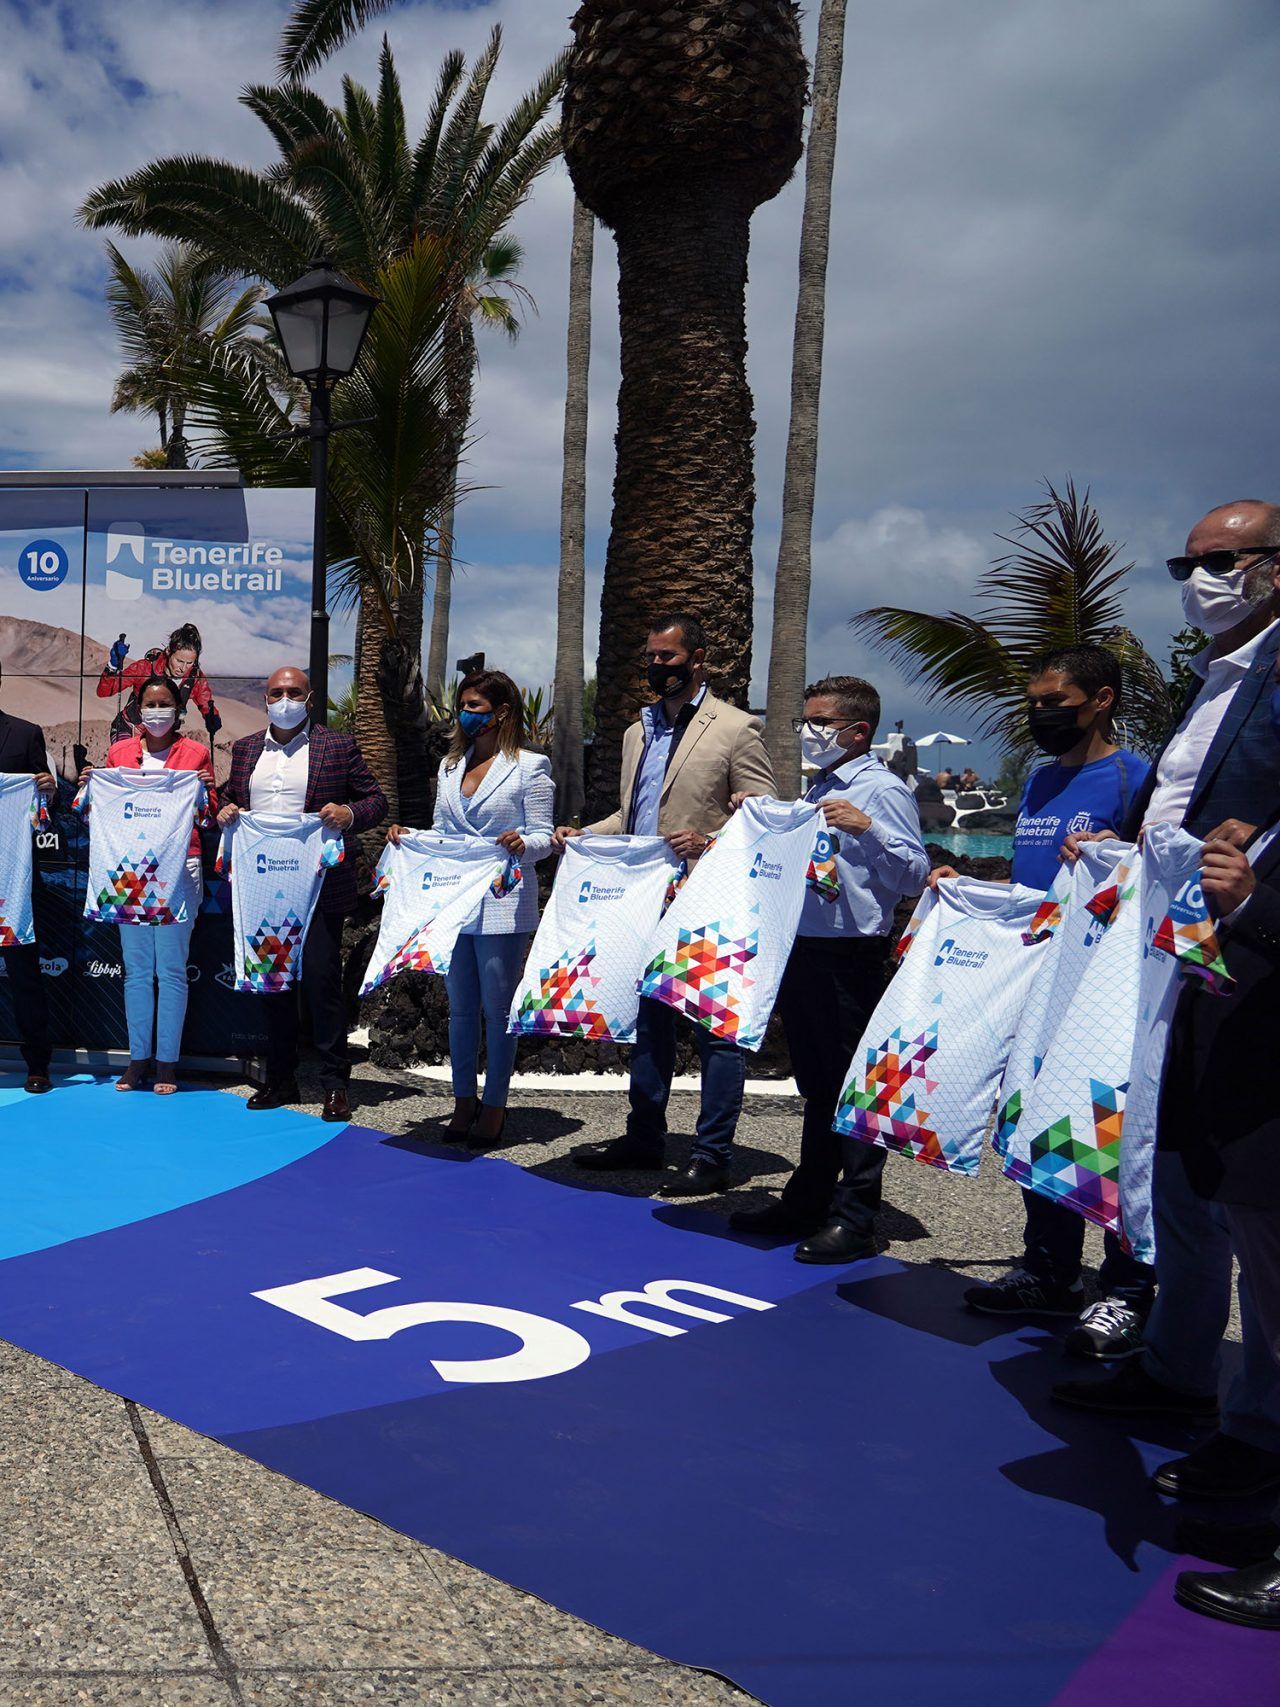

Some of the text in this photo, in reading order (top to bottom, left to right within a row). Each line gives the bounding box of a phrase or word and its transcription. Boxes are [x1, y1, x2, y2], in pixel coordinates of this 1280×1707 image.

[151, 542, 283, 565] Tenerife
[27, 551, 60, 574] 10
[151, 568, 282, 591] Bluetrail
[36, 833, 60, 850] 021
[589, 893, 624, 901] Bluetrail
[591, 886, 626, 895] Tenerife
[1170, 904, 1202, 919] niversario
[953, 947, 989, 960] Tenerife
[82, 960, 122, 978] Libby's
[946, 956, 985, 969] Bluetrail
[249, 1267, 778, 1383] 5 m
